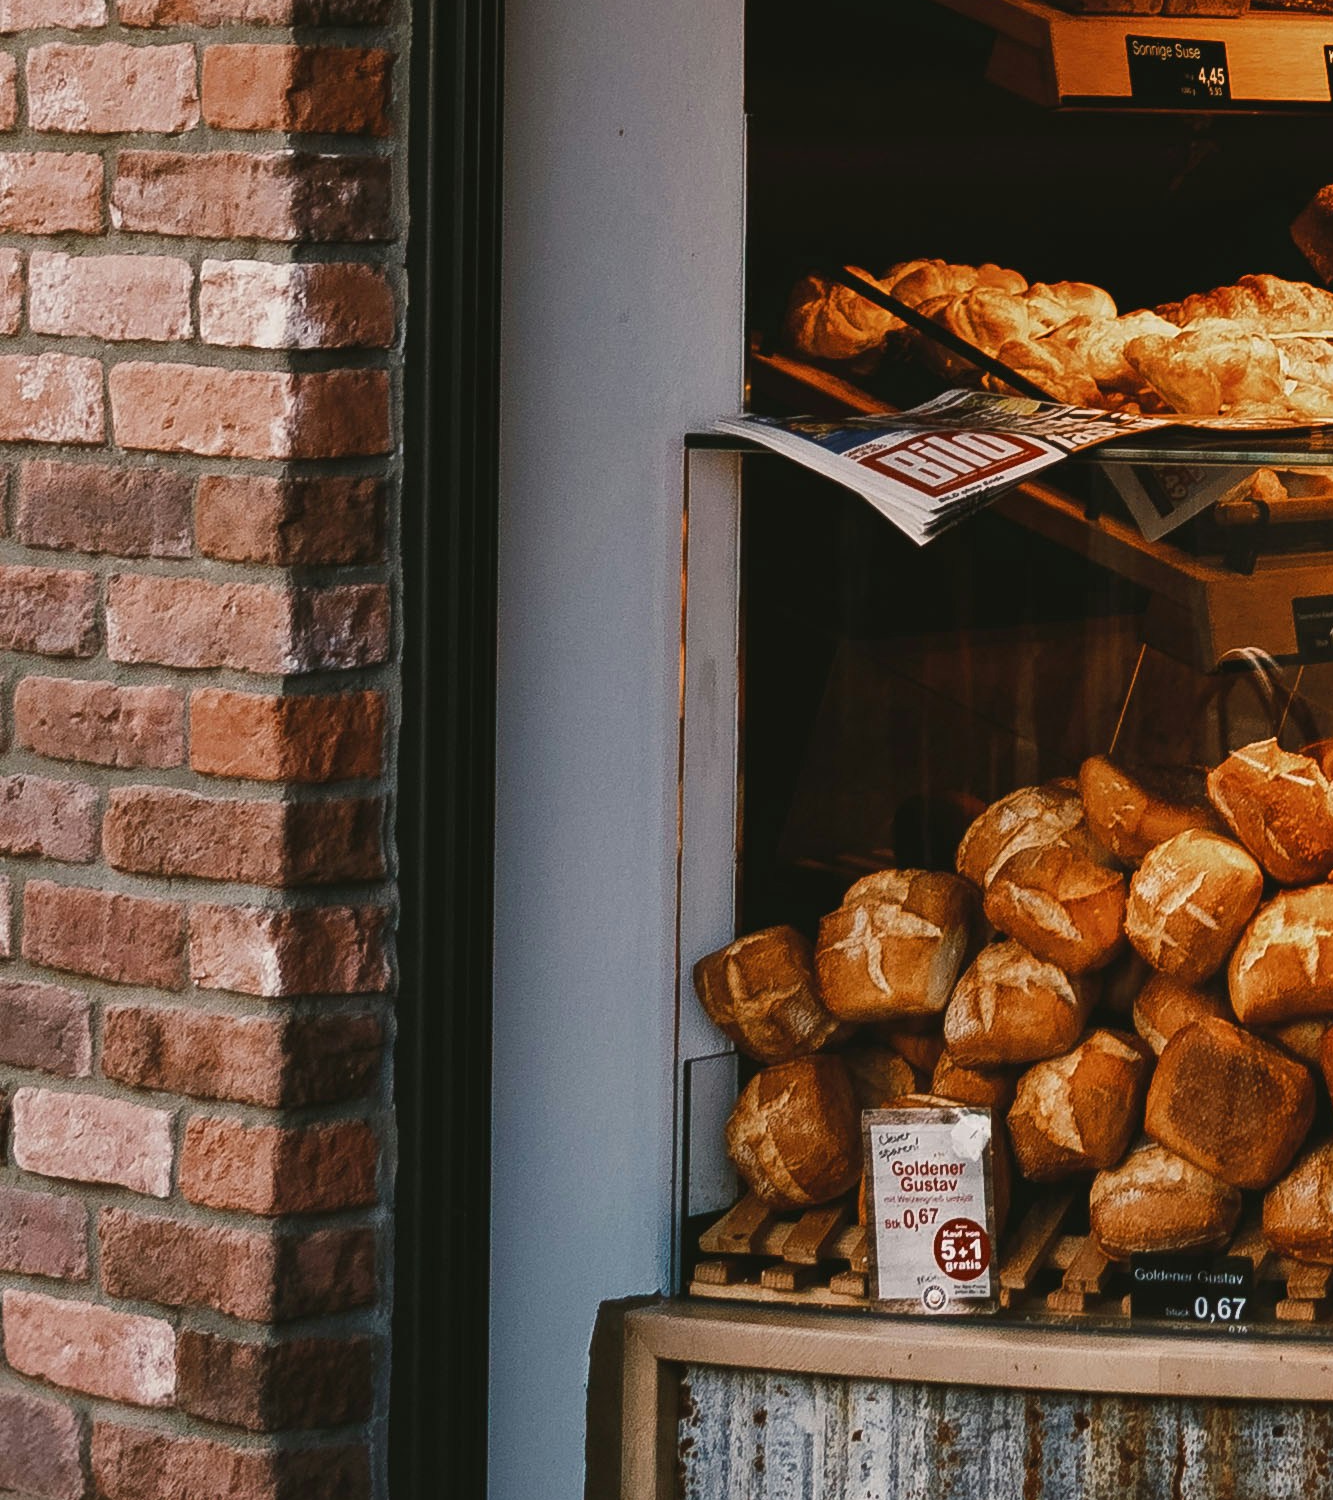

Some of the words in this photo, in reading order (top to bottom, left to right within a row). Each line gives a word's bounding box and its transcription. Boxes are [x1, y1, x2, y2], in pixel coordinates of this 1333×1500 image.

[1132, 40, 1172, 60] Sonnige
[1175, 43, 1201, 59] Suse
[1198, 67, 1225, 87] 4,45
[892, 1160, 966, 1176] Goldener
[900, 1176, 958, 1192] Gustav
[903, 1208, 939, 1232] 0,67
[945, 1259, 982, 1273] gratis
[1134, 1267, 1192, 1282] Goldener
[1197, 1271, 1244, 1286] Gustav
[1194, 1296, 1246, 1323] 0,67
